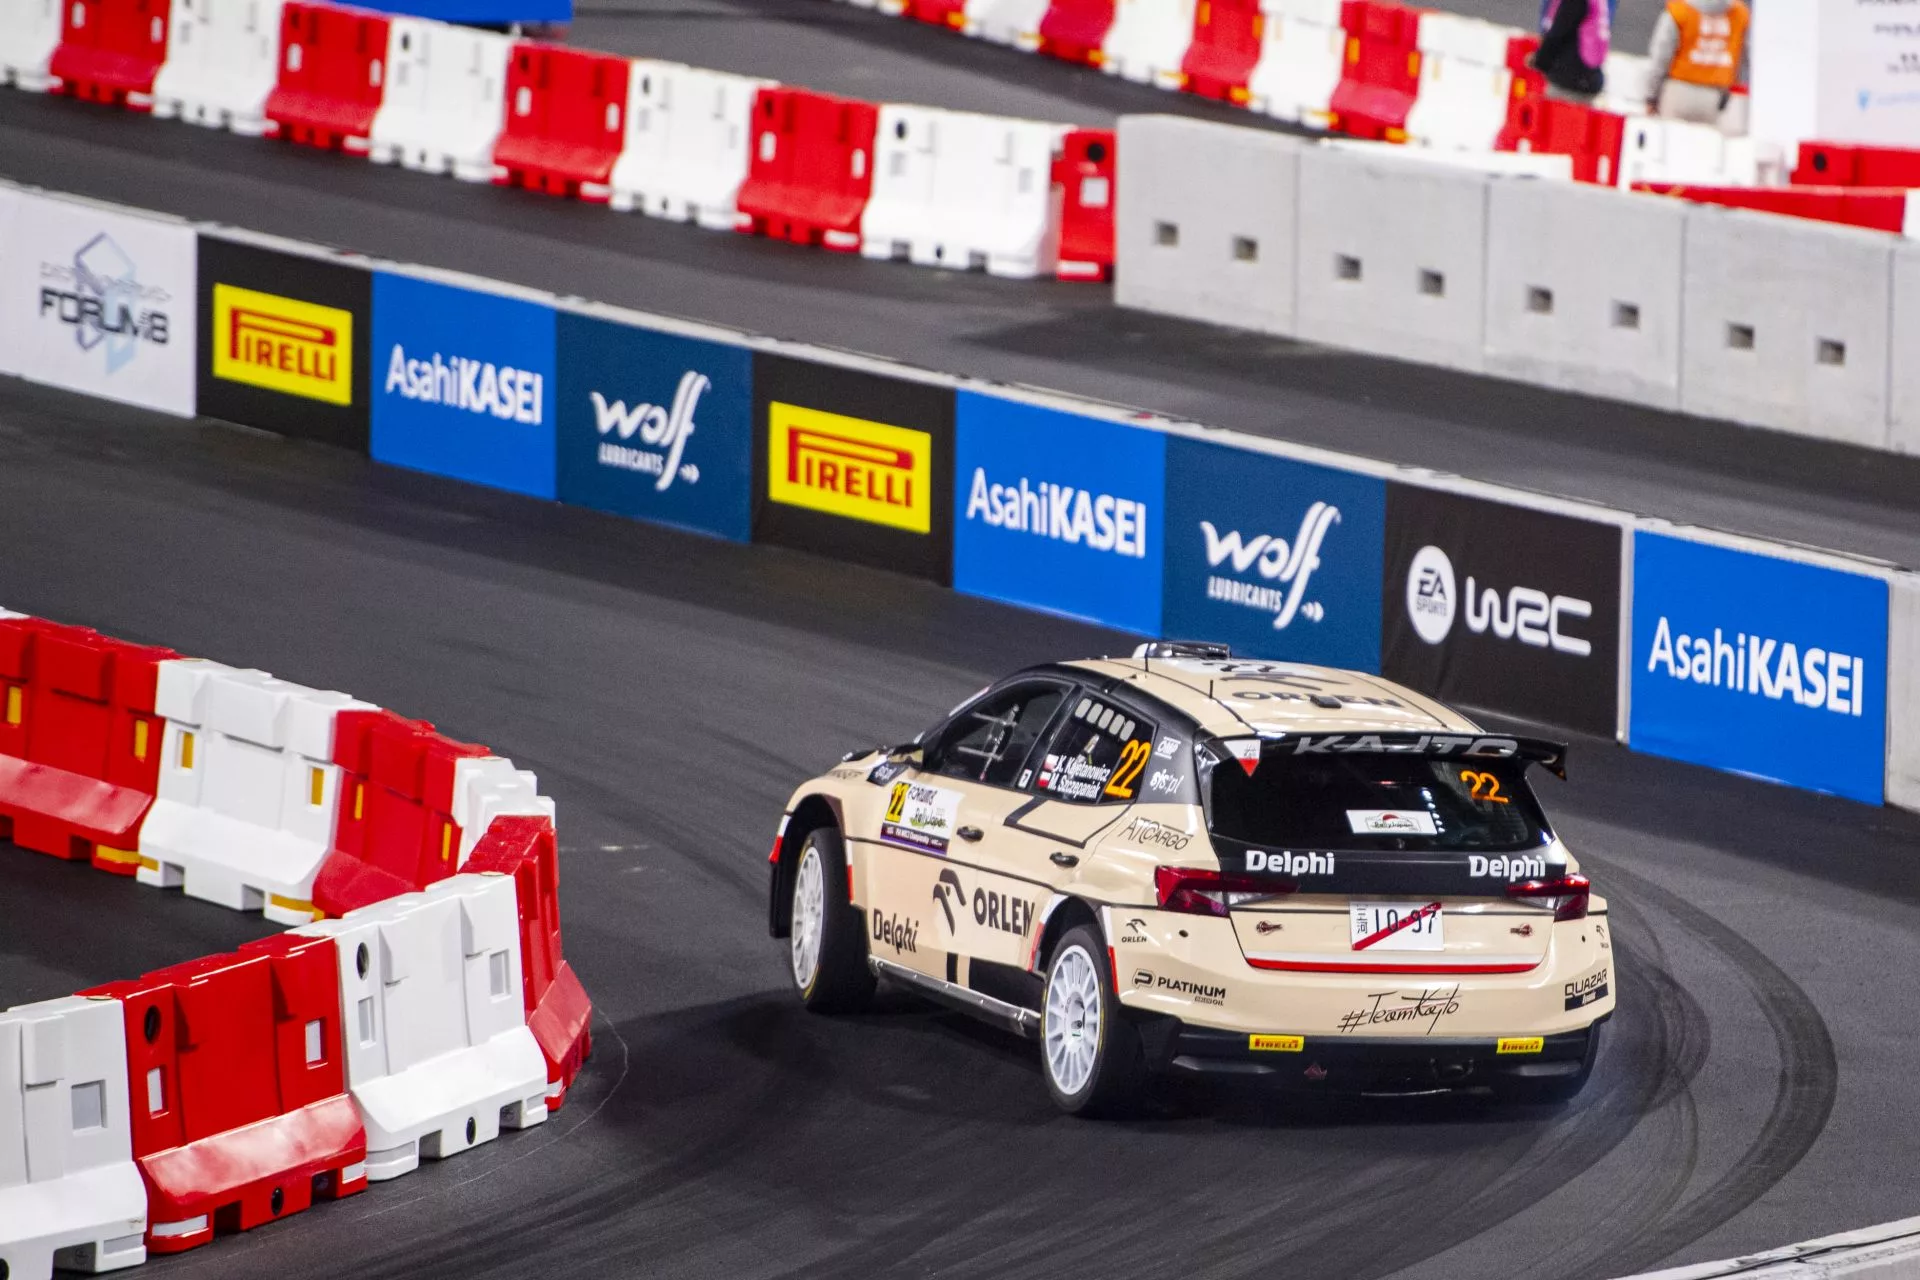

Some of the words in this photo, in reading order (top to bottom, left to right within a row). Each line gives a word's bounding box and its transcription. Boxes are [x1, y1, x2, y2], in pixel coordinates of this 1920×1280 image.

[229, 307, 337, 383] PIRELLI
[598, 441, 666, 476] LUBRICANTS
[787, 426, 914, 508] PIRELLI
[1207, 575, 1283, 613] LUBRICANTS
[1419, 567, 1447, 600] EA
[1465, 576, 1592, 656] WRC
[1292, 735, 1518, 757] KAJTO
[1104, 739, 1151, 798] 22
[1460, 770, 1509, 804] 22
[1245, 851, 1335, 876] Delphi
[1469, 855, 1546, 881] Delphi
[973, 887, 1036, 938] ORLEN
[873, 908, 919, 954] Delphi
[1157, 976, 1226, 998] PLATINUM
[1564, 968, 1608, 997] QUAZAR
[1338, 983, 1461, 1035] #TeamKajto
[1254, 1038, 1299, 1050] PIRELLI
